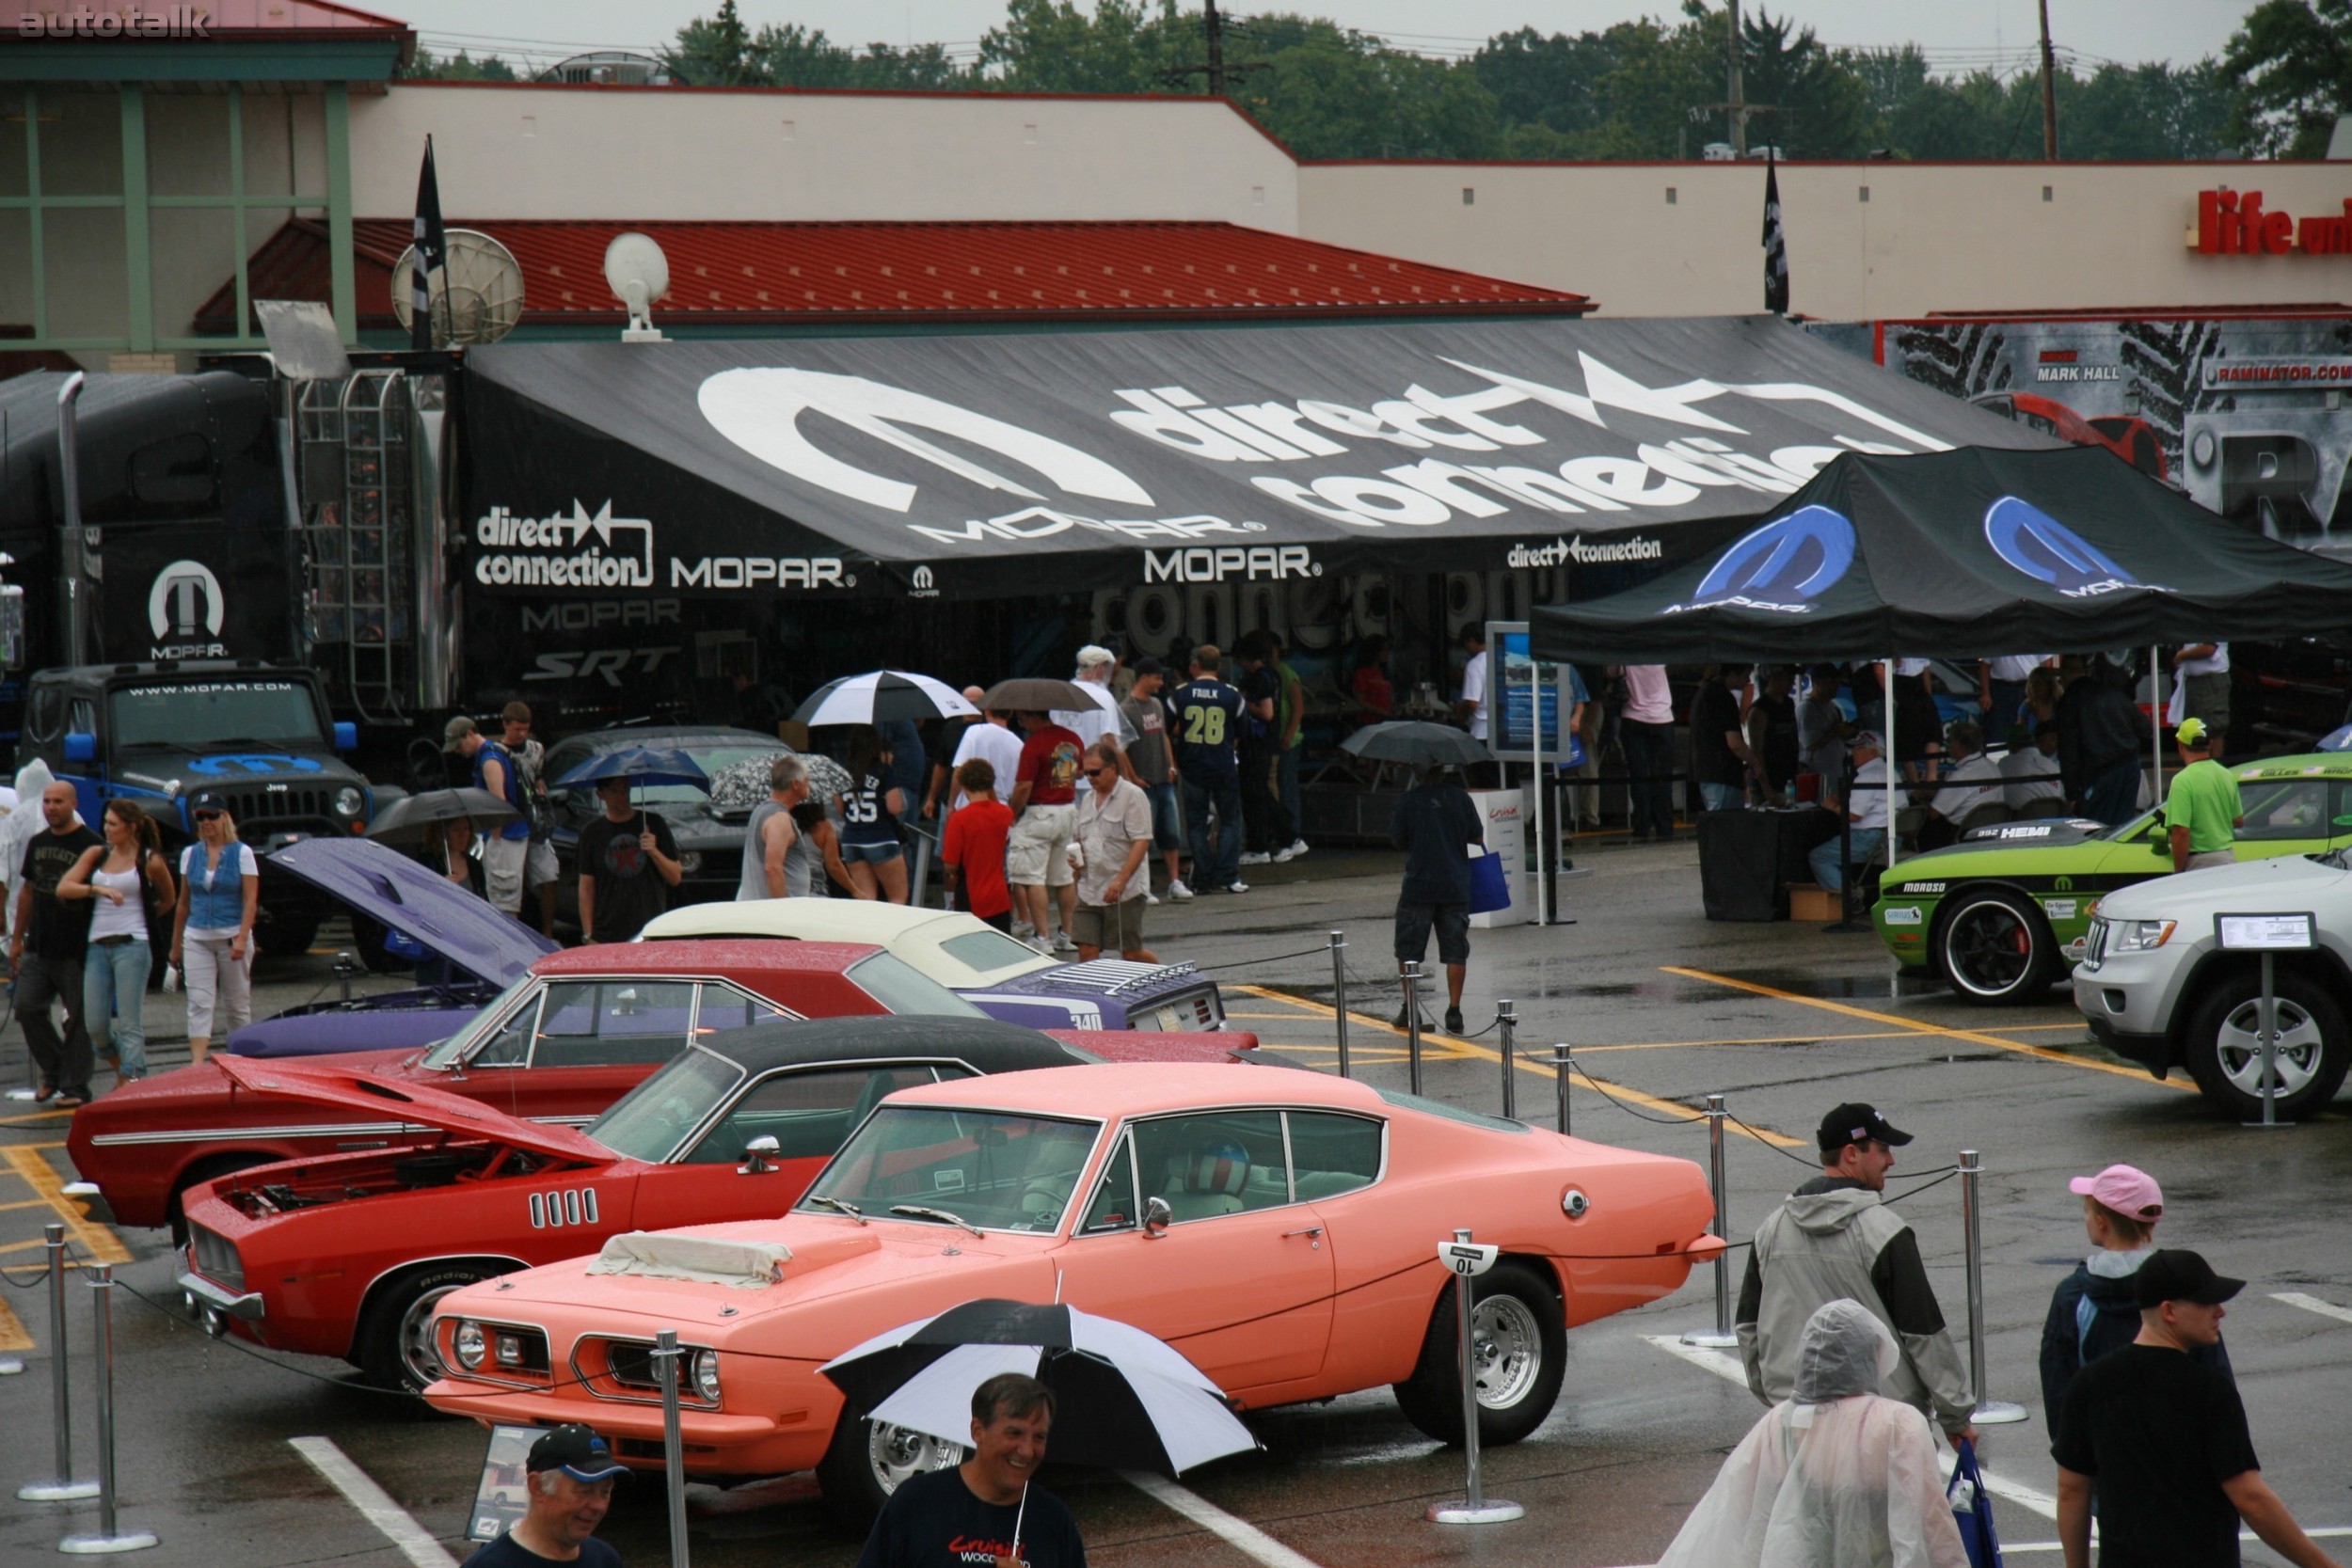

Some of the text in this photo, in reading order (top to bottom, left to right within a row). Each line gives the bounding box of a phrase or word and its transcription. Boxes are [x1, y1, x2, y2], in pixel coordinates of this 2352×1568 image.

[2199, 190, 2293, 255] life
[2037, 367, 2120, 382] MARK HALL
[2218, 365, 2352, 382] RAMINATOR.COM
[1109, 382, 1548, 462] direct
[477, 506, 564, 546] direct
[476, 546, 640, 587] connection
[1145, 546, 1311, 583] MOPAR
[1507, 535, 1662, 568] direct connection
[671, 557, 845, 589] MOPAR
[522, 599, 681, 632] MOPAR
[521, 645, 682, 688] SRT
[130, 683, 292, 697] WWW.MOPAR.COM
[1192, 688, 1219, 699] FAULK
[1184, 705, 1227, 745] 28
[266, 784, 288, 792] Jeep
[842, 792, 879, 823] 35
[2000, 826, 2052, 839] HEMI
[1903, 882, 1947, 893] MOROSO
[1885, 911, 1912, 920] SIRIUS
[1070, 1013, 1103, 1031] 340
[421, 1272, 474, 1288] Radial
